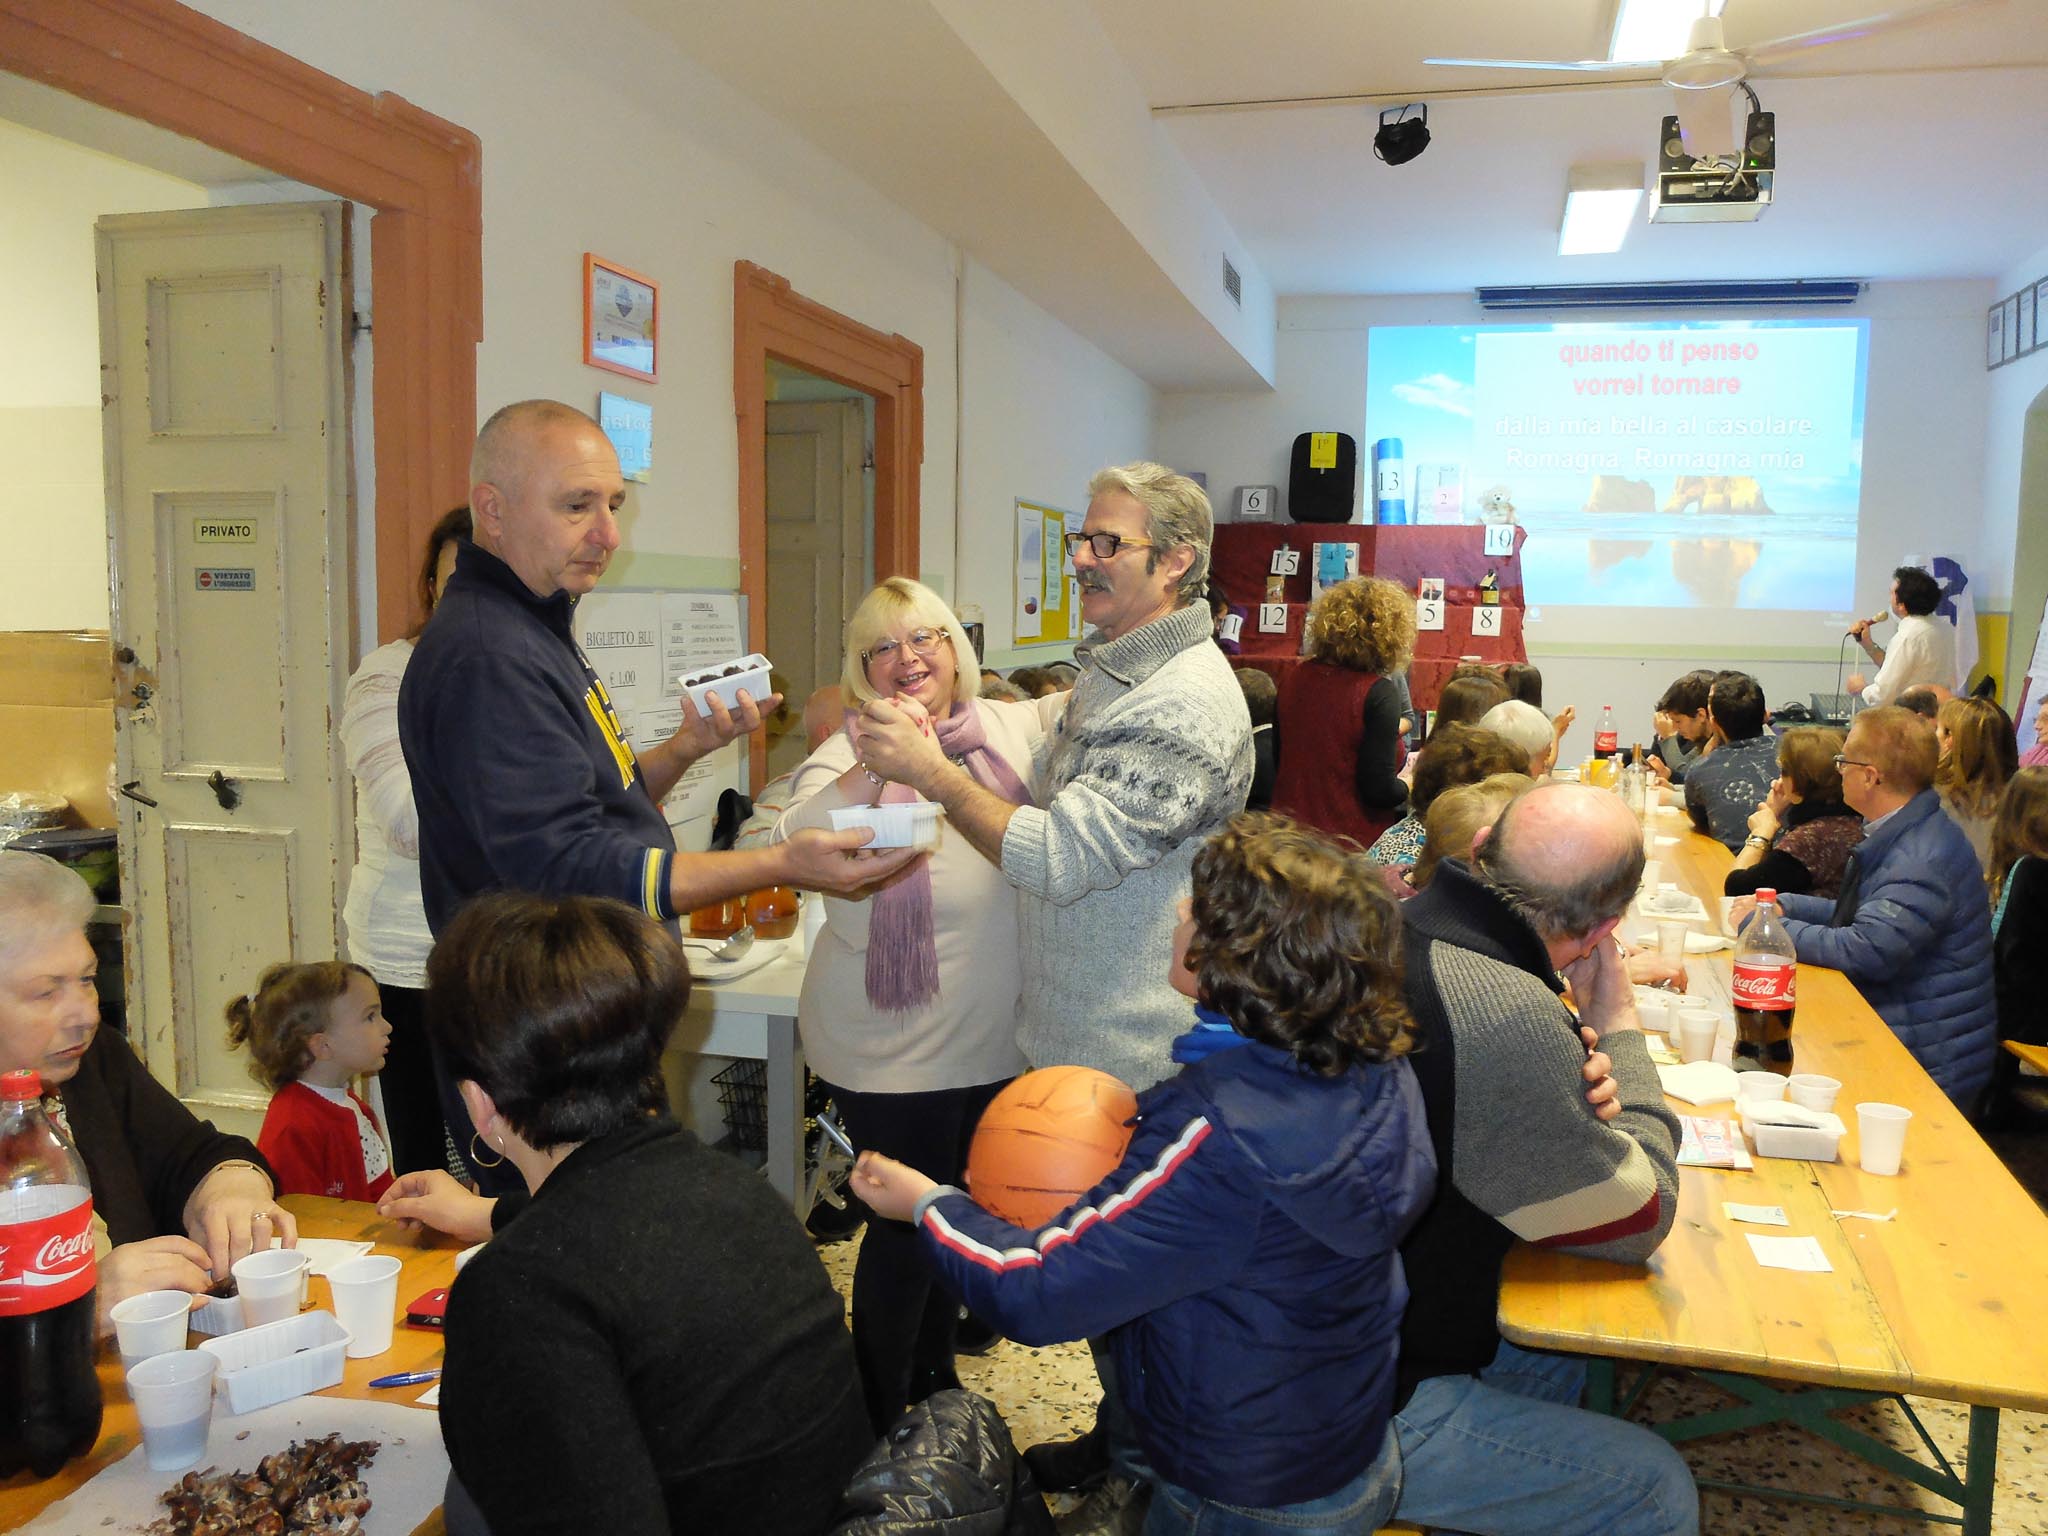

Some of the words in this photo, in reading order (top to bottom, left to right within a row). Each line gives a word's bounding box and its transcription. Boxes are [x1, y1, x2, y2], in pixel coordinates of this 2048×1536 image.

[1559, 339, 1651, 367] quando
[1658, 339, 1674, 362] ti
[1681, 342, 1759, 366] penso
[1573, 373, 1643, 395] vorrei
[1651, 374, 1741, 395] tornare
[1495, 415, 1551, 435] dalla
[1559, 416, 1600, 434] mia
[1611, 415, 1667, 435] bella
[1677, 415, 1697, 434] al
[1635, 448, 1751, 472] Romagna
[1760, 449, 1805, 470] mia
[1379, 472, 1399, 491] 13
[1248, 491, 1260, 508] 6
[201, 525, 250, 536] PRIVATO
[1489, 529, 1512, 547] 10
[1274, 553, 1297, 573] 15
[214, 572, 250, 580] VIETATO
[1262, 606, 1285, 625] 12
[1424, 604, 1435, 622] 5
[1480, 609, 1493, 629] 8
[586, 631, 635, 646] BIGLIETTO
